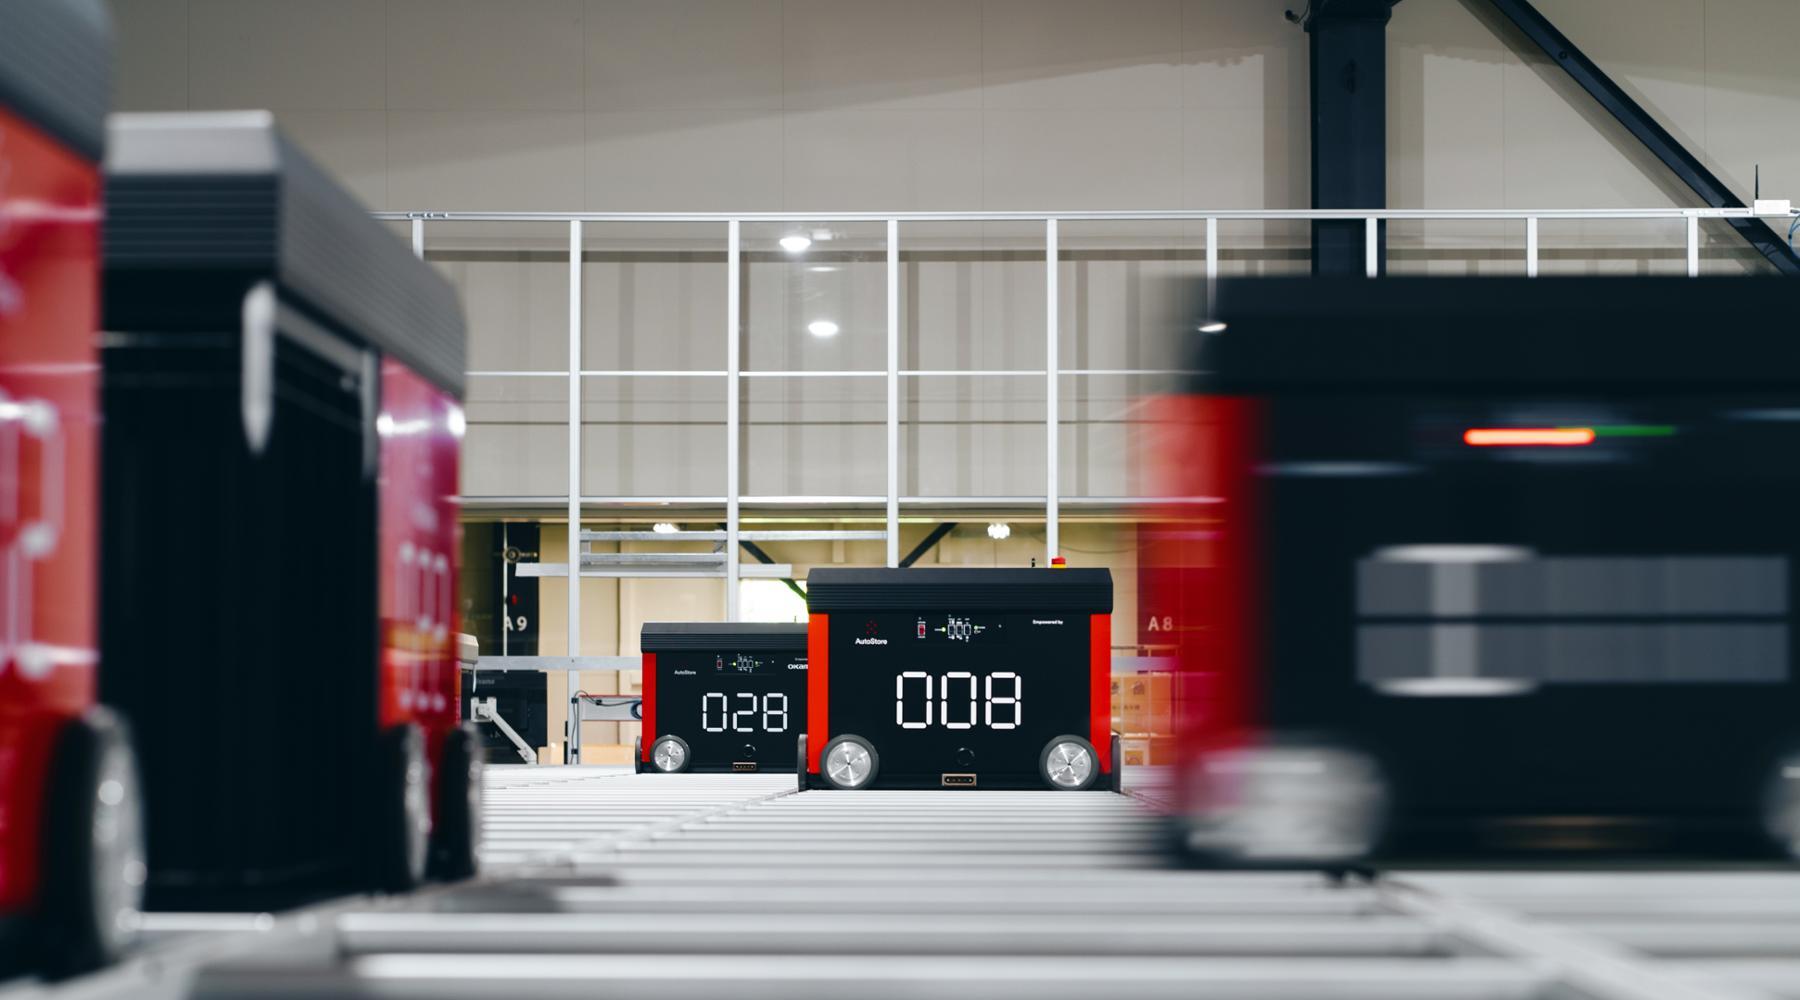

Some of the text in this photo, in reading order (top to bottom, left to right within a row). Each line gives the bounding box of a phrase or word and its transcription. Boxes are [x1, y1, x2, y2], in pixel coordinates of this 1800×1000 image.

[854, 637, 888, 645] AutoStore
[702, 692, 788, 733] 028
[896, 671, 1022, 730] 008
